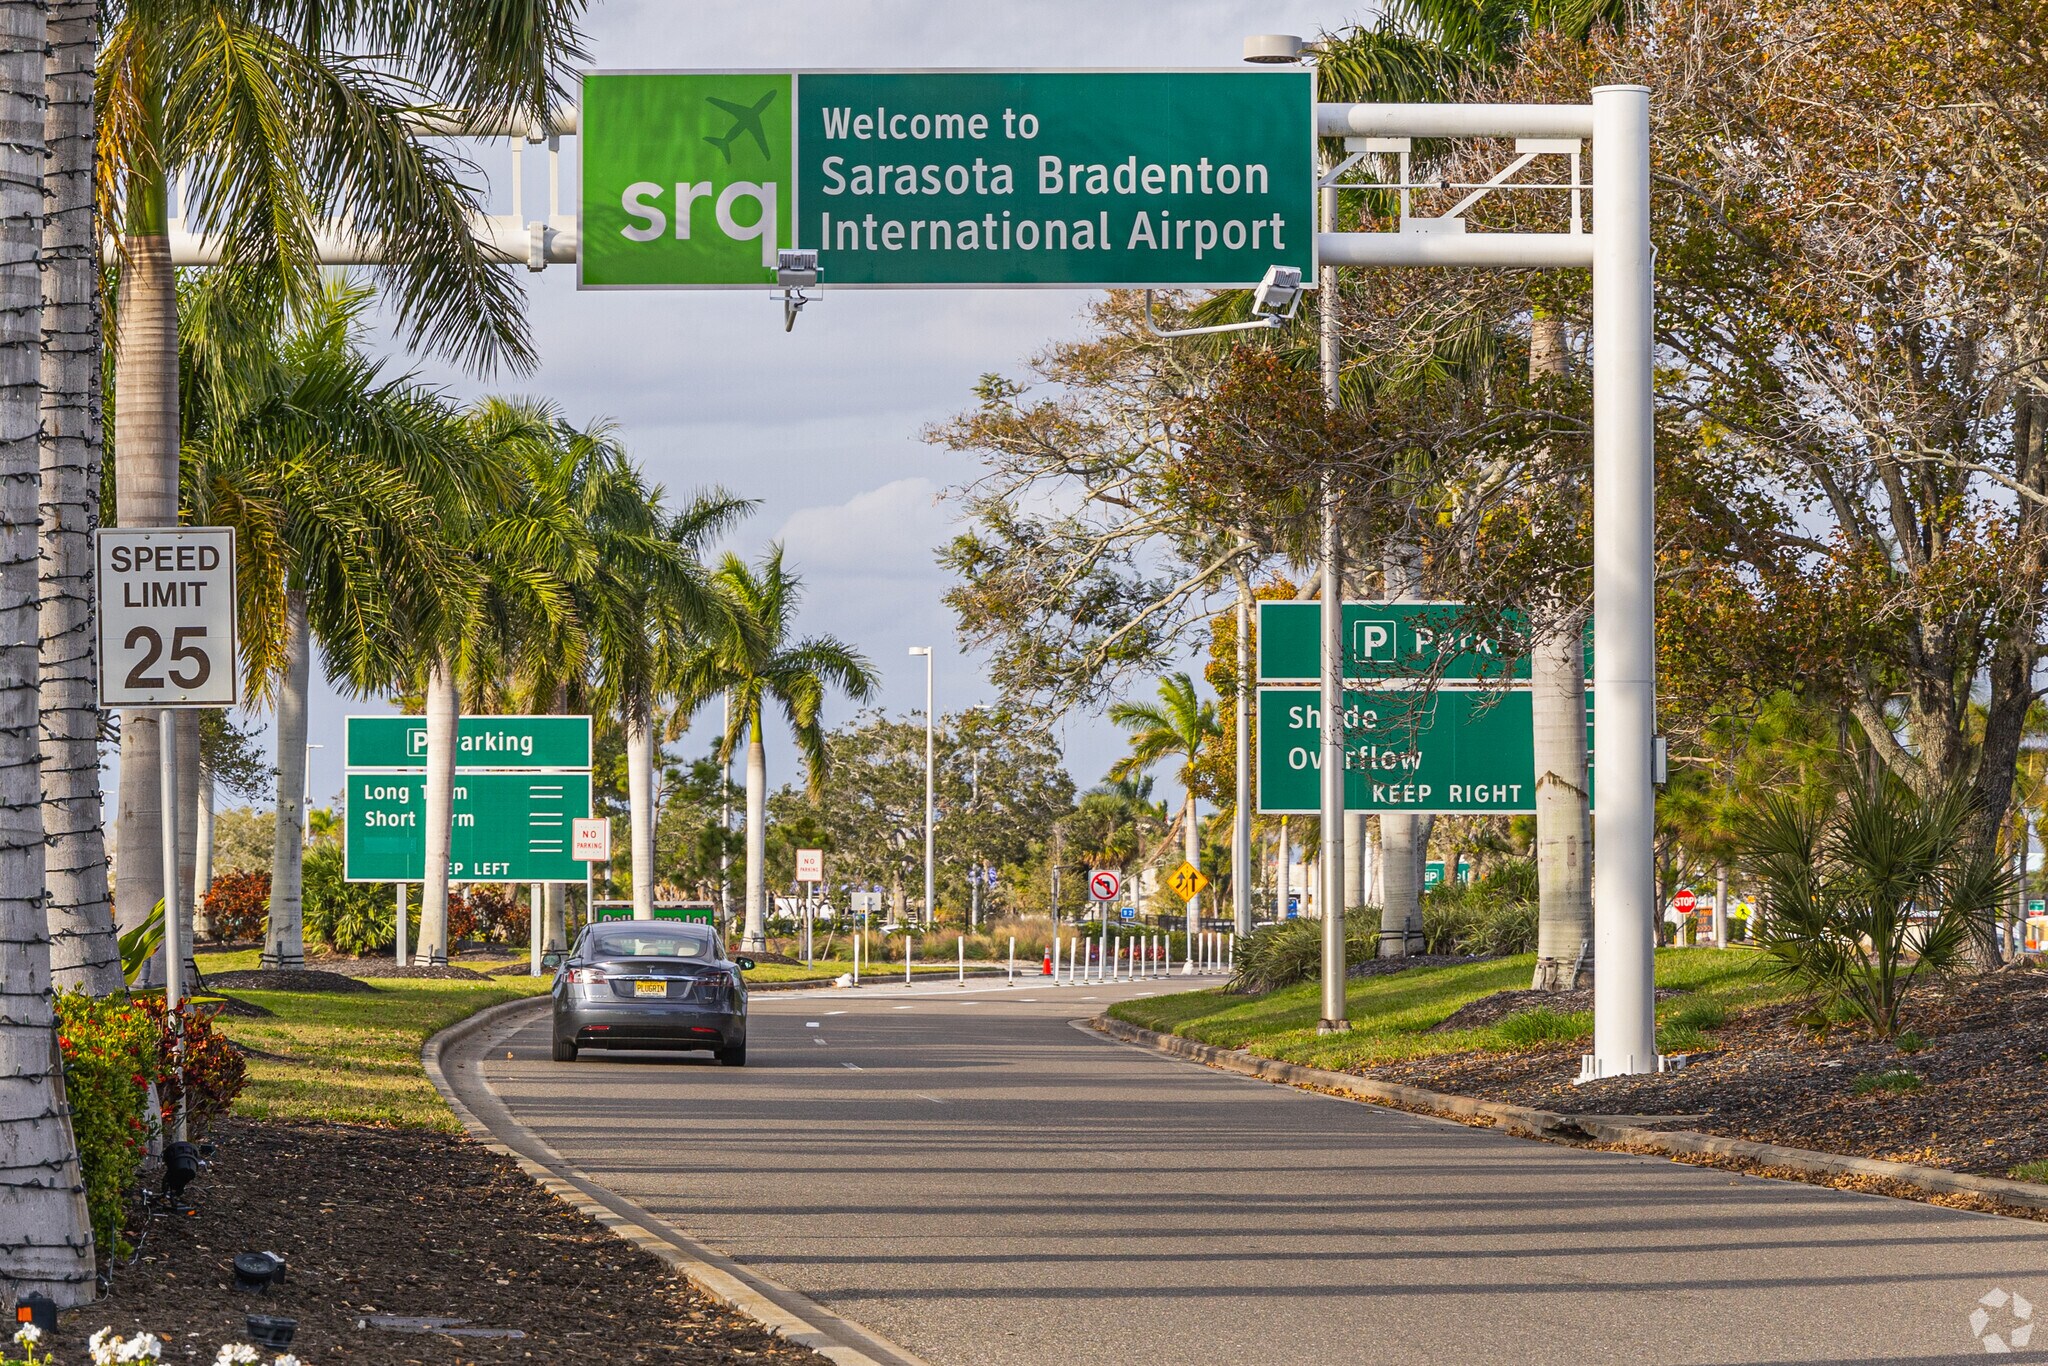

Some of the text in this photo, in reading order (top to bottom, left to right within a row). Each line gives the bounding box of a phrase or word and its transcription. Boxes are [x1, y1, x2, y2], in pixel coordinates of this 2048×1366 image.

[822, 107, 1039, 140] Welcome to
[822, 155, 1269, 196] Sarasota Bradenton
[620, 181, 777, 267] srq
[821, 210, 1285, 260] International Airport
[111, 545, 220, 573] SPEED
[123, 581, 208, 608] LIMIT
[1364, 625, 1389, 658] P
[123, 625, 211, 690] 25
[1288, 704, 1379, 729] Shde
[455, 731, 534, 756] arking
[1288, 745, 1423, 771] Ovrflow
[364, 784, 468, 804] Long Tm
[1373, 784, 1522, 803] KEEP RIGHT
[364, 810, 416, 828] Short
[582, 830, 597, 839] NO
[448, 862, 510, 876] EP LEFT
[1674, 896, 1694, 908] STOP
[637, 984, 665, 993] PLUGRIN
